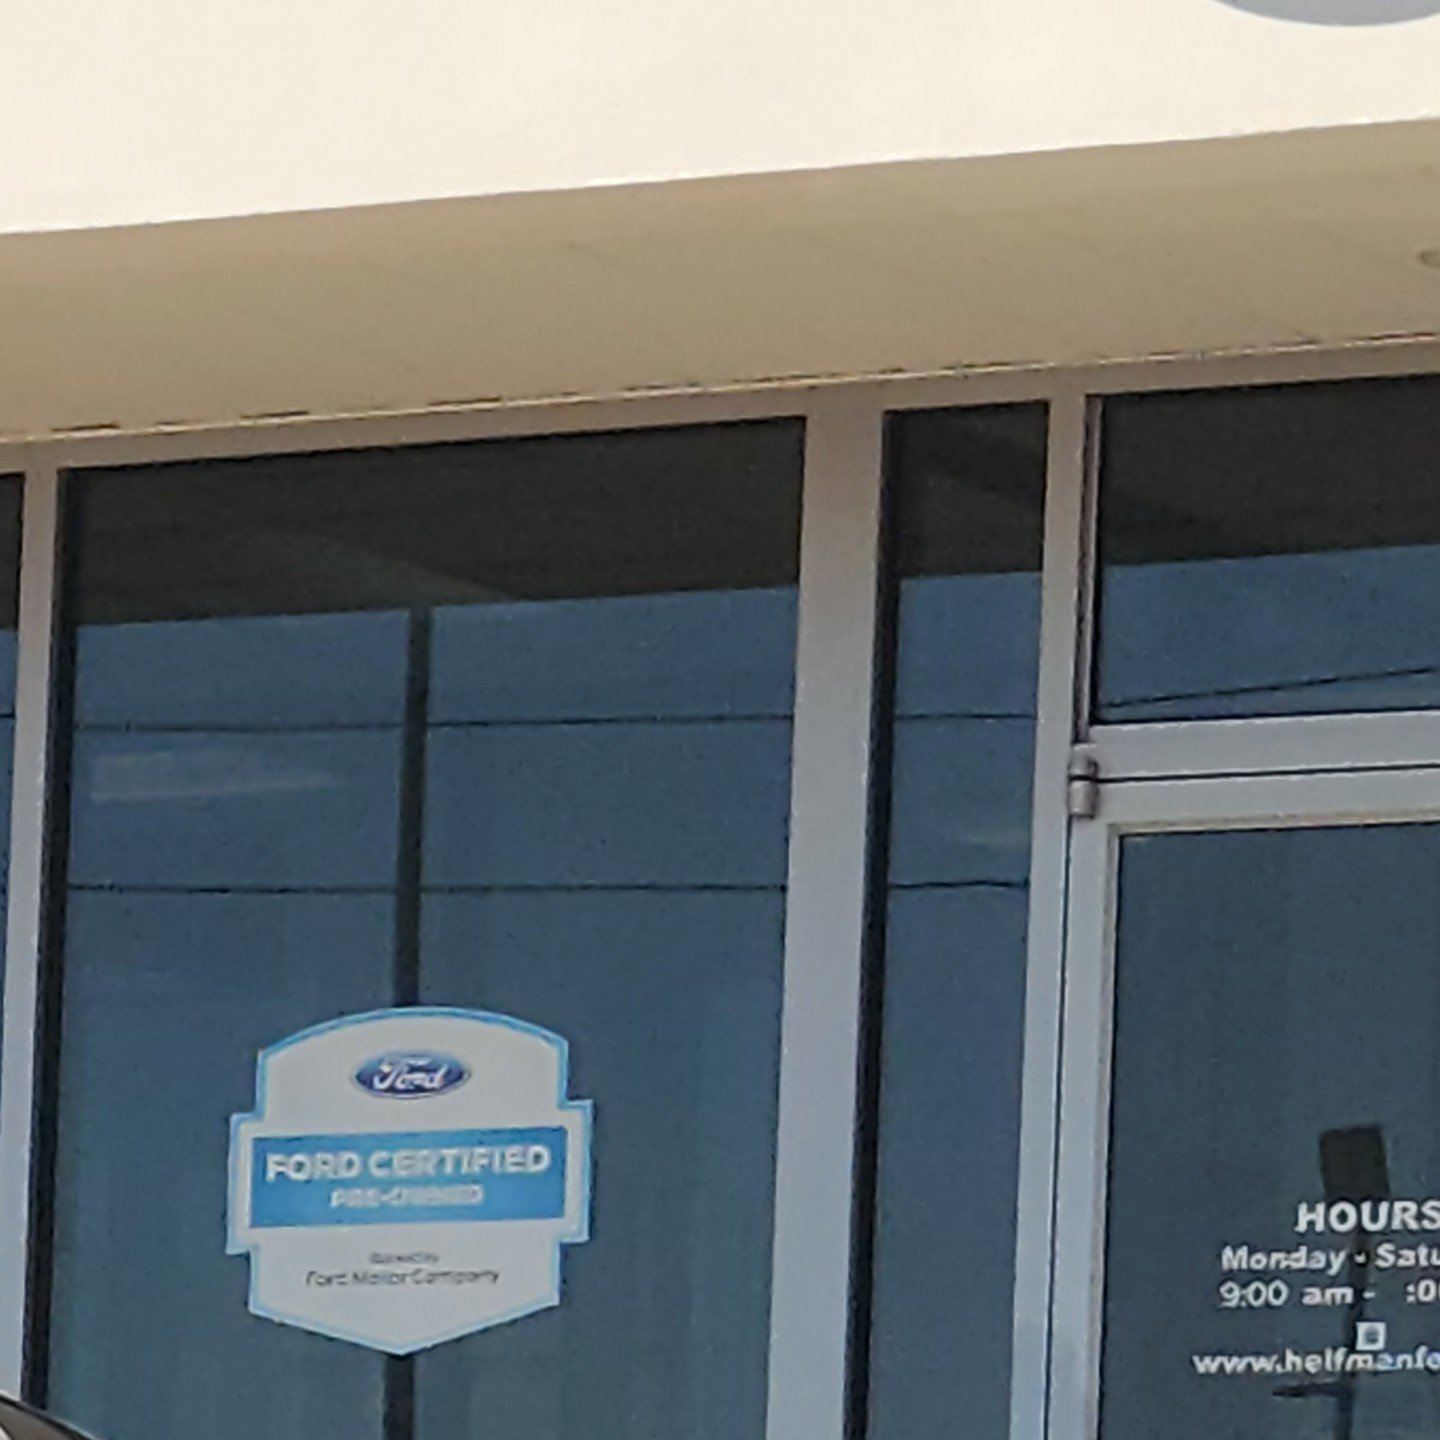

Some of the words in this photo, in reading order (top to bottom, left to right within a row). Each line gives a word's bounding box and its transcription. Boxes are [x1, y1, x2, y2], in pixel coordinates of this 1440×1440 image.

[372, 1056, 449, 1090] Ford
[266, 1151, 361, 1182] FORD
[368, 1145, 552, 1179] CERTIFIED
[1293, 1200, 1440, 1233] HOURS
[1221, 1245, 1347, 1275] Monday
[1219, 1278, 1290, 1309] 9:00
[1301, 1285, 1355, 1305] am
